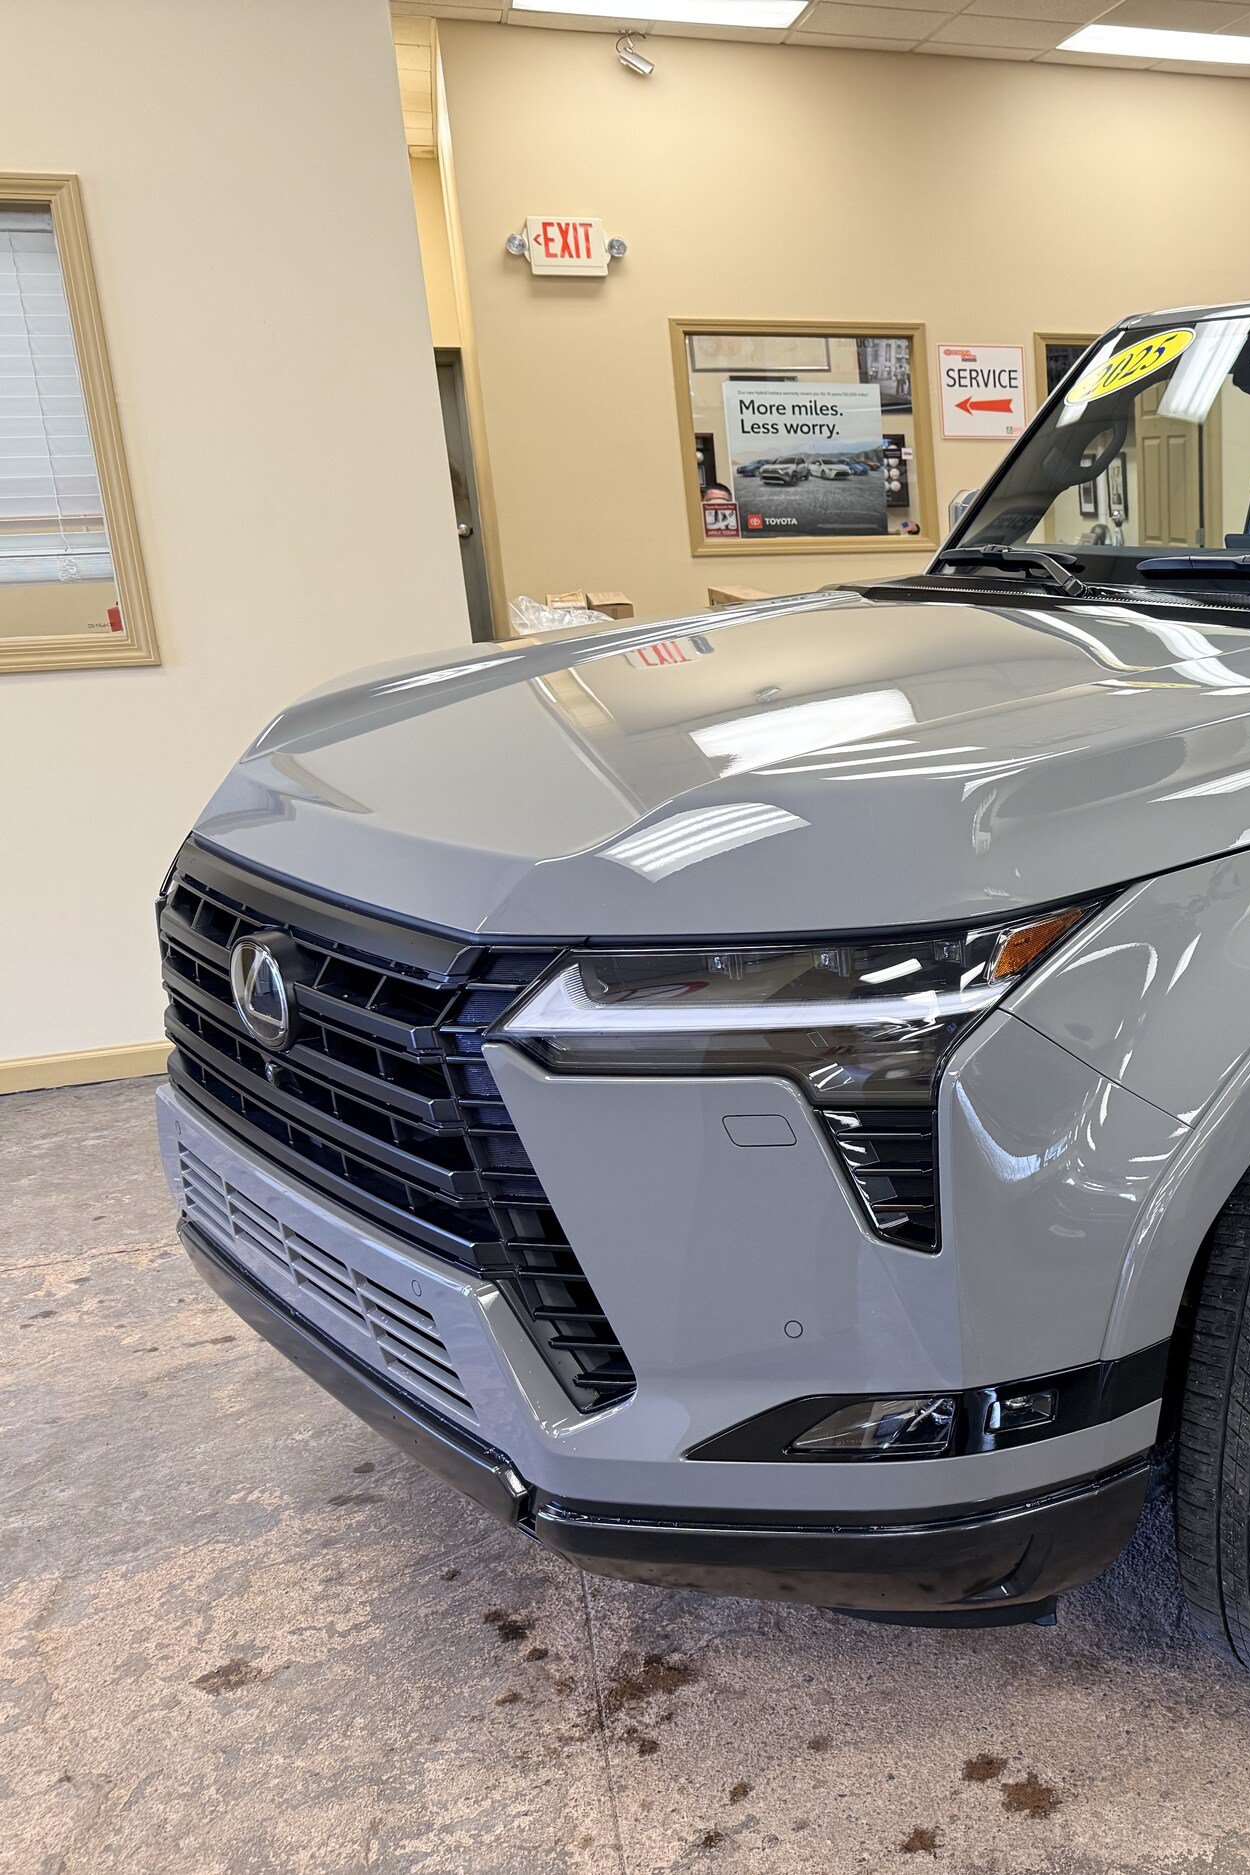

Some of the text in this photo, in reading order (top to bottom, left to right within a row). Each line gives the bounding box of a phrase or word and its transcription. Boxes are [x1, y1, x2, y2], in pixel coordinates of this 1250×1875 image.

[541, 222, 593, 259] EXIT
[1080, 333, 1179, 399] 2025
[946, 368, 1018, 388] SERVICE
[739, 400, 843, 416] More miles.
[741, 419, 840, 438] Less worry.
